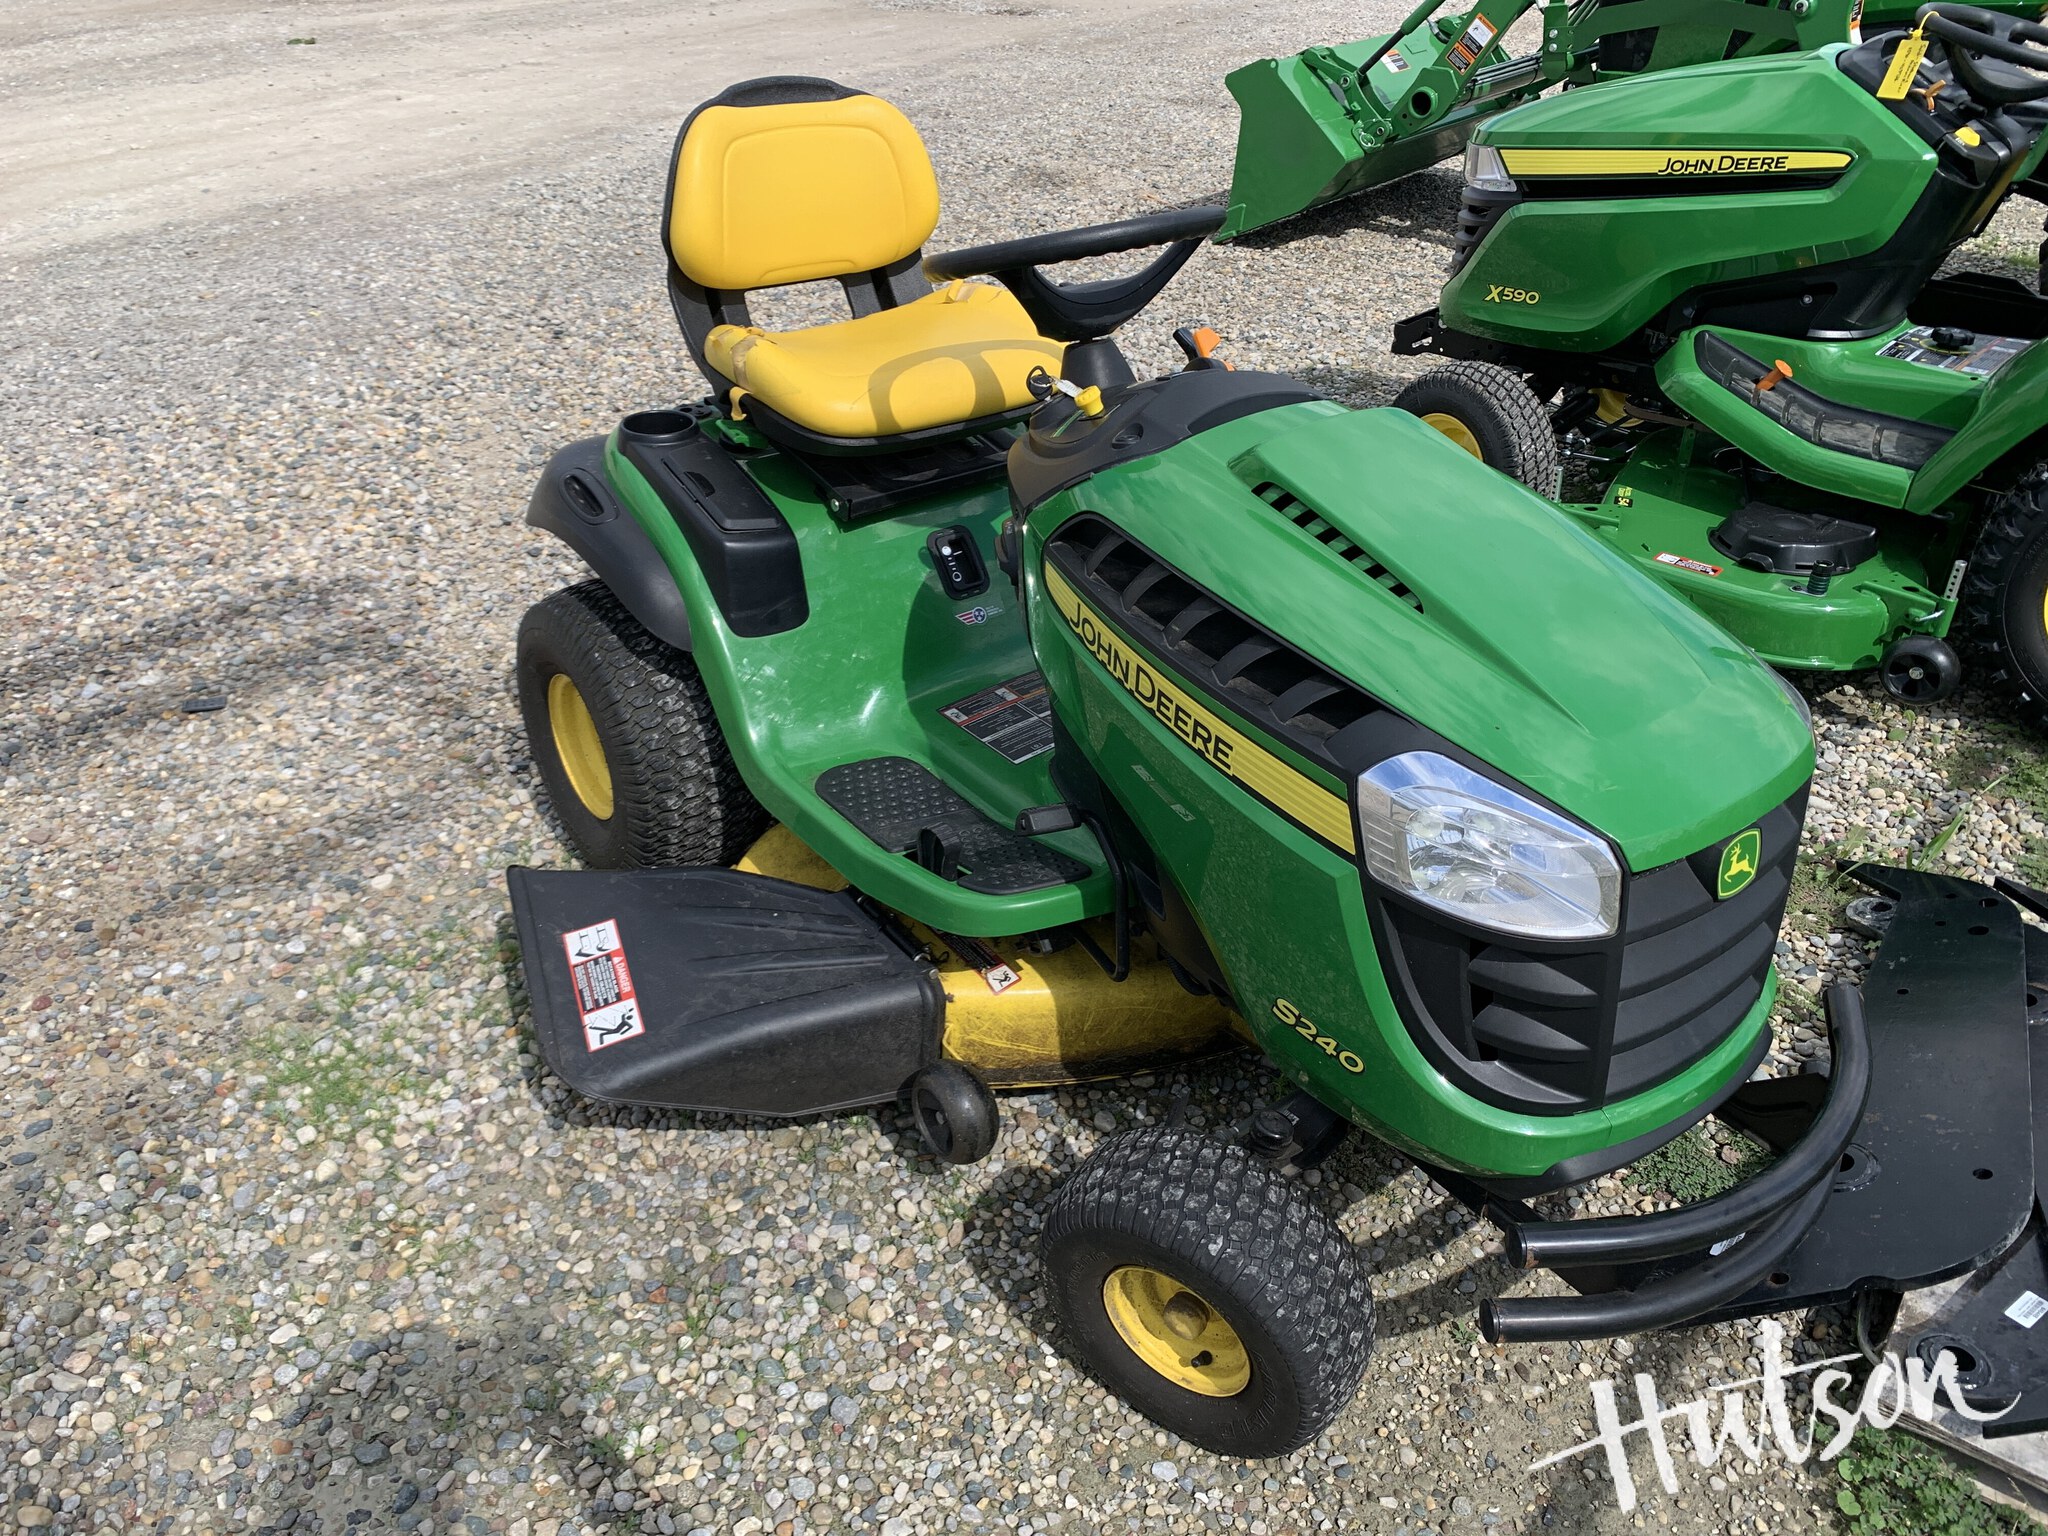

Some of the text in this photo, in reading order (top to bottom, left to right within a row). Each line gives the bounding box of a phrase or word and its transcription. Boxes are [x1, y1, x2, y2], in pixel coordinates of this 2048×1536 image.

[1657, 155, 1789, 174] JOHN DEERE
[1483, 284, 1540, 305] X590
[1069, 602, 1130, 686] JOHN
[1134, 664, 1234, 771] DEERE
[616, 962, 632, 994] DANGER
[1272, 998, 1365, 1074] S240
